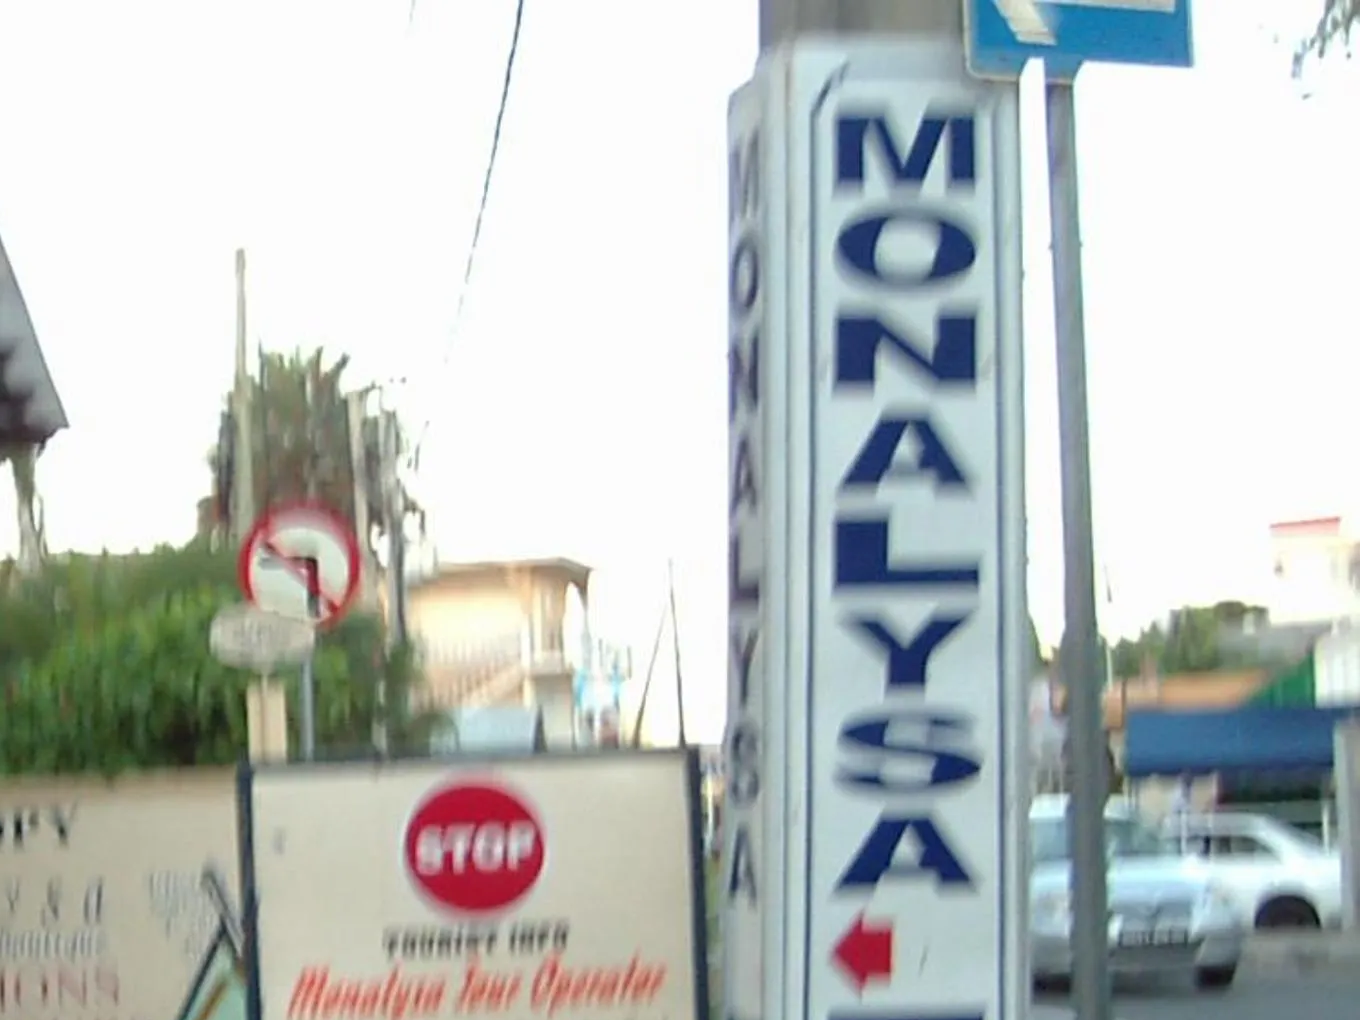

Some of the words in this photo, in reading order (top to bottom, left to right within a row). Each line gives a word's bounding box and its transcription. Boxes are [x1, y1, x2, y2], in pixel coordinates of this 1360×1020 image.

[832, 108, 985, 896] MONALYSA
[414, 819, 538, 876] STOP
[454, 953, 524, 1013] Tour
[529, 943, 668, 1020] Operator
